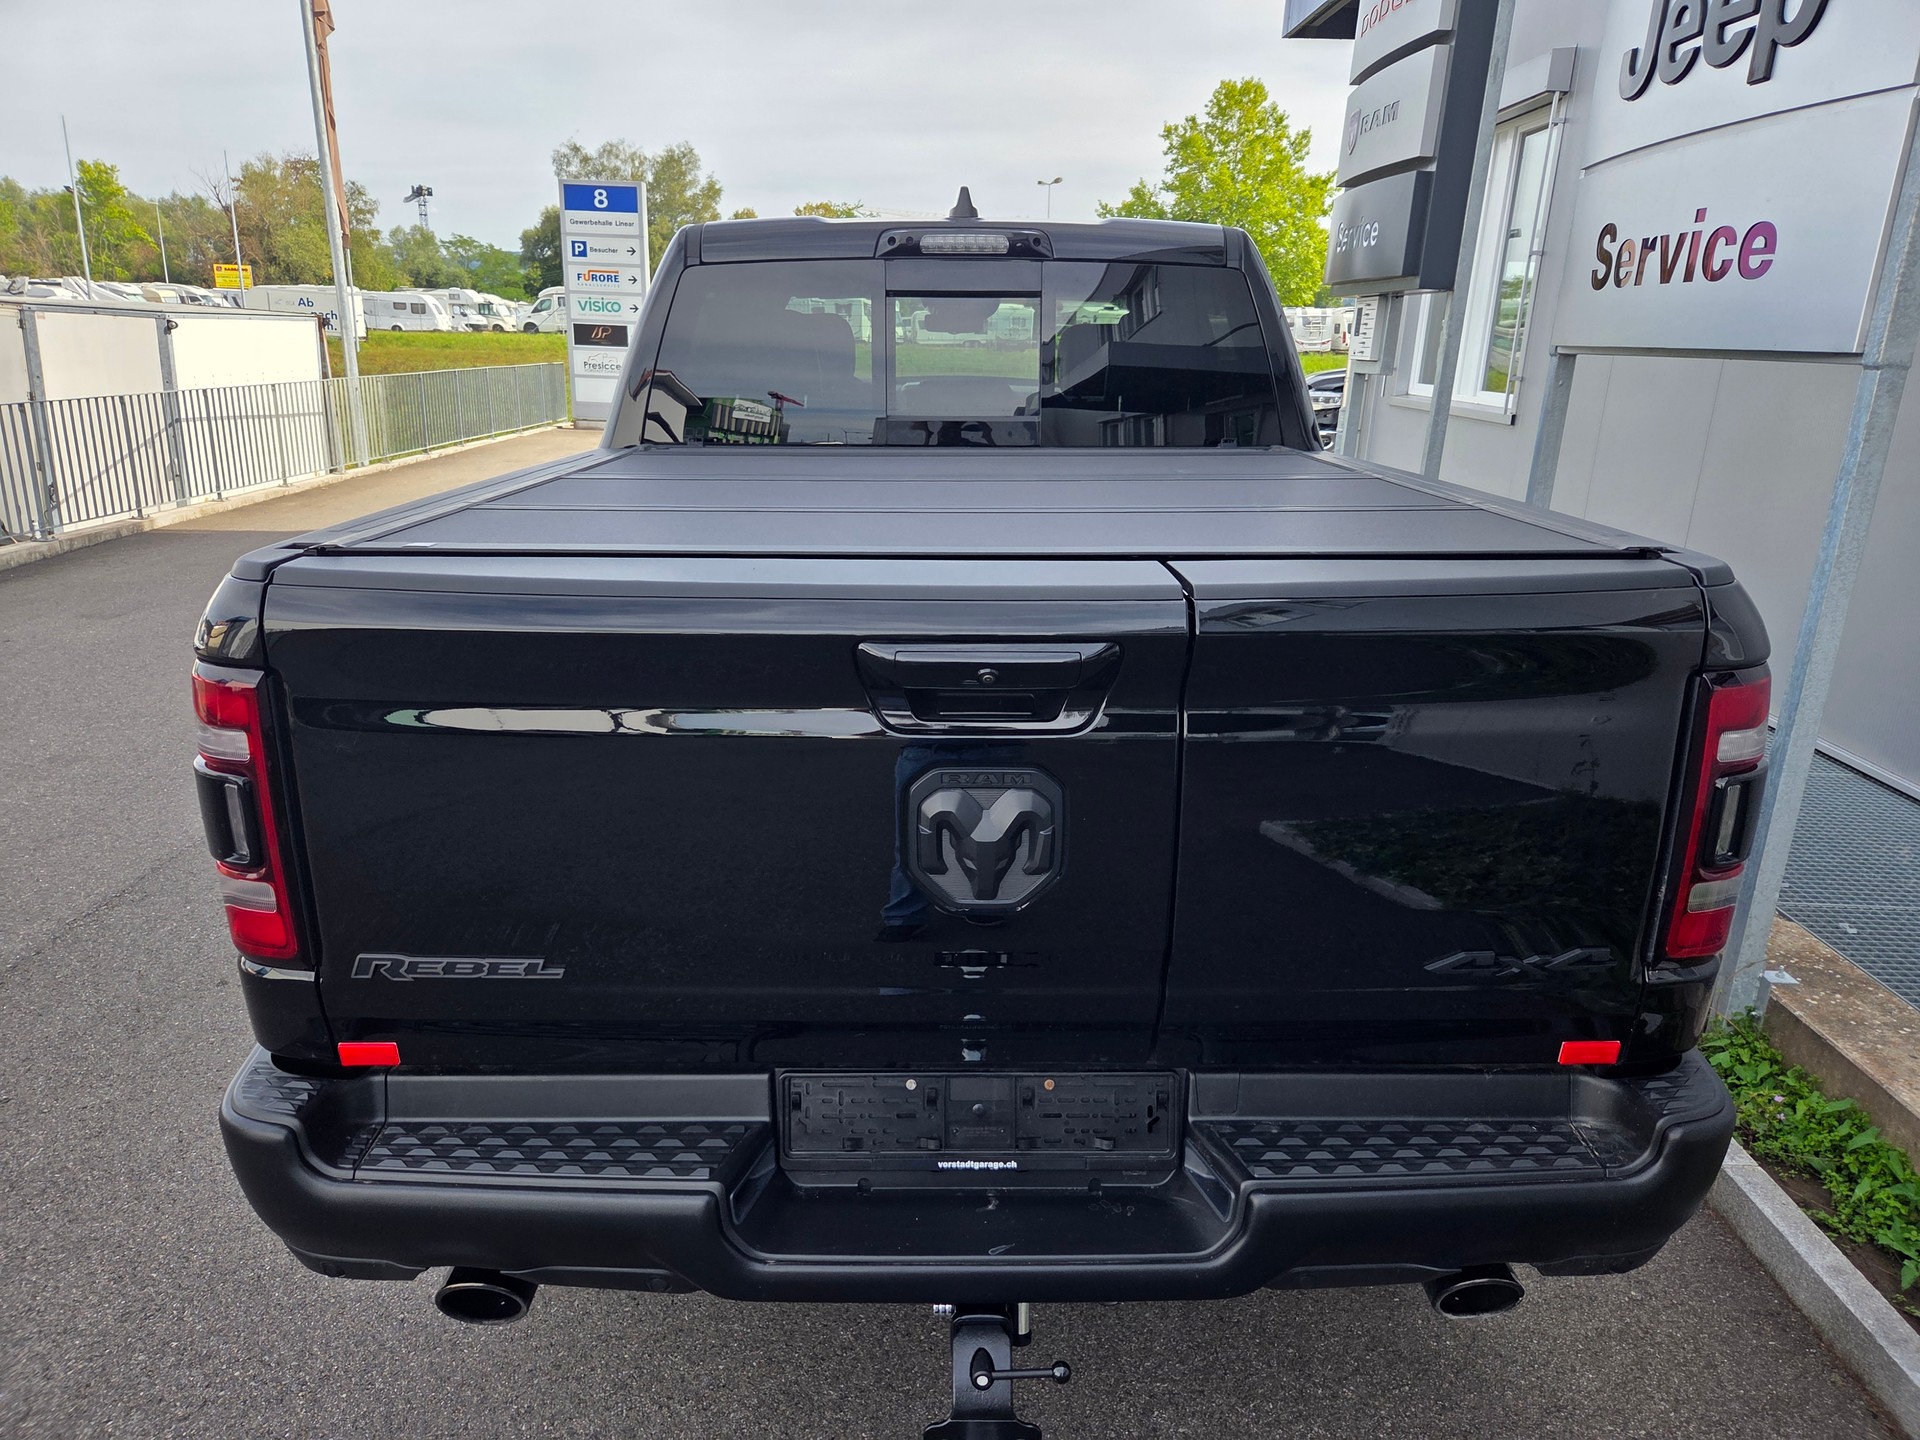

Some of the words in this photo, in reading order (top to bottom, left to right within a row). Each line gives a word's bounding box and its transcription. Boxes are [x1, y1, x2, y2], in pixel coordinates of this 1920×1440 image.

[1361, 0, 1415, 38] DOD
[1619, 0, 1830, 101] Jeep
[1360, 100, 1400, 136] RAM
[594, 189, 608, 208] 8
[570, 218, 613, 227] Gewerbehalle
[1335, 215, 1379, 253] Service
[574, 243, 584, 255] P
[1591, 208, 1779, 291] Service
[577, 270, 620, 283] FURORE
[298, 297, 314, 307] Ab
[577, 297, 621, 313] visico
[583, 361, 621, 371] Presicce
[941, 773, 1033, 785] RAM
[351, 952, 566, 981] REBEL
[938, 1160, 1017, 1170] vorstadtgarage.ch
